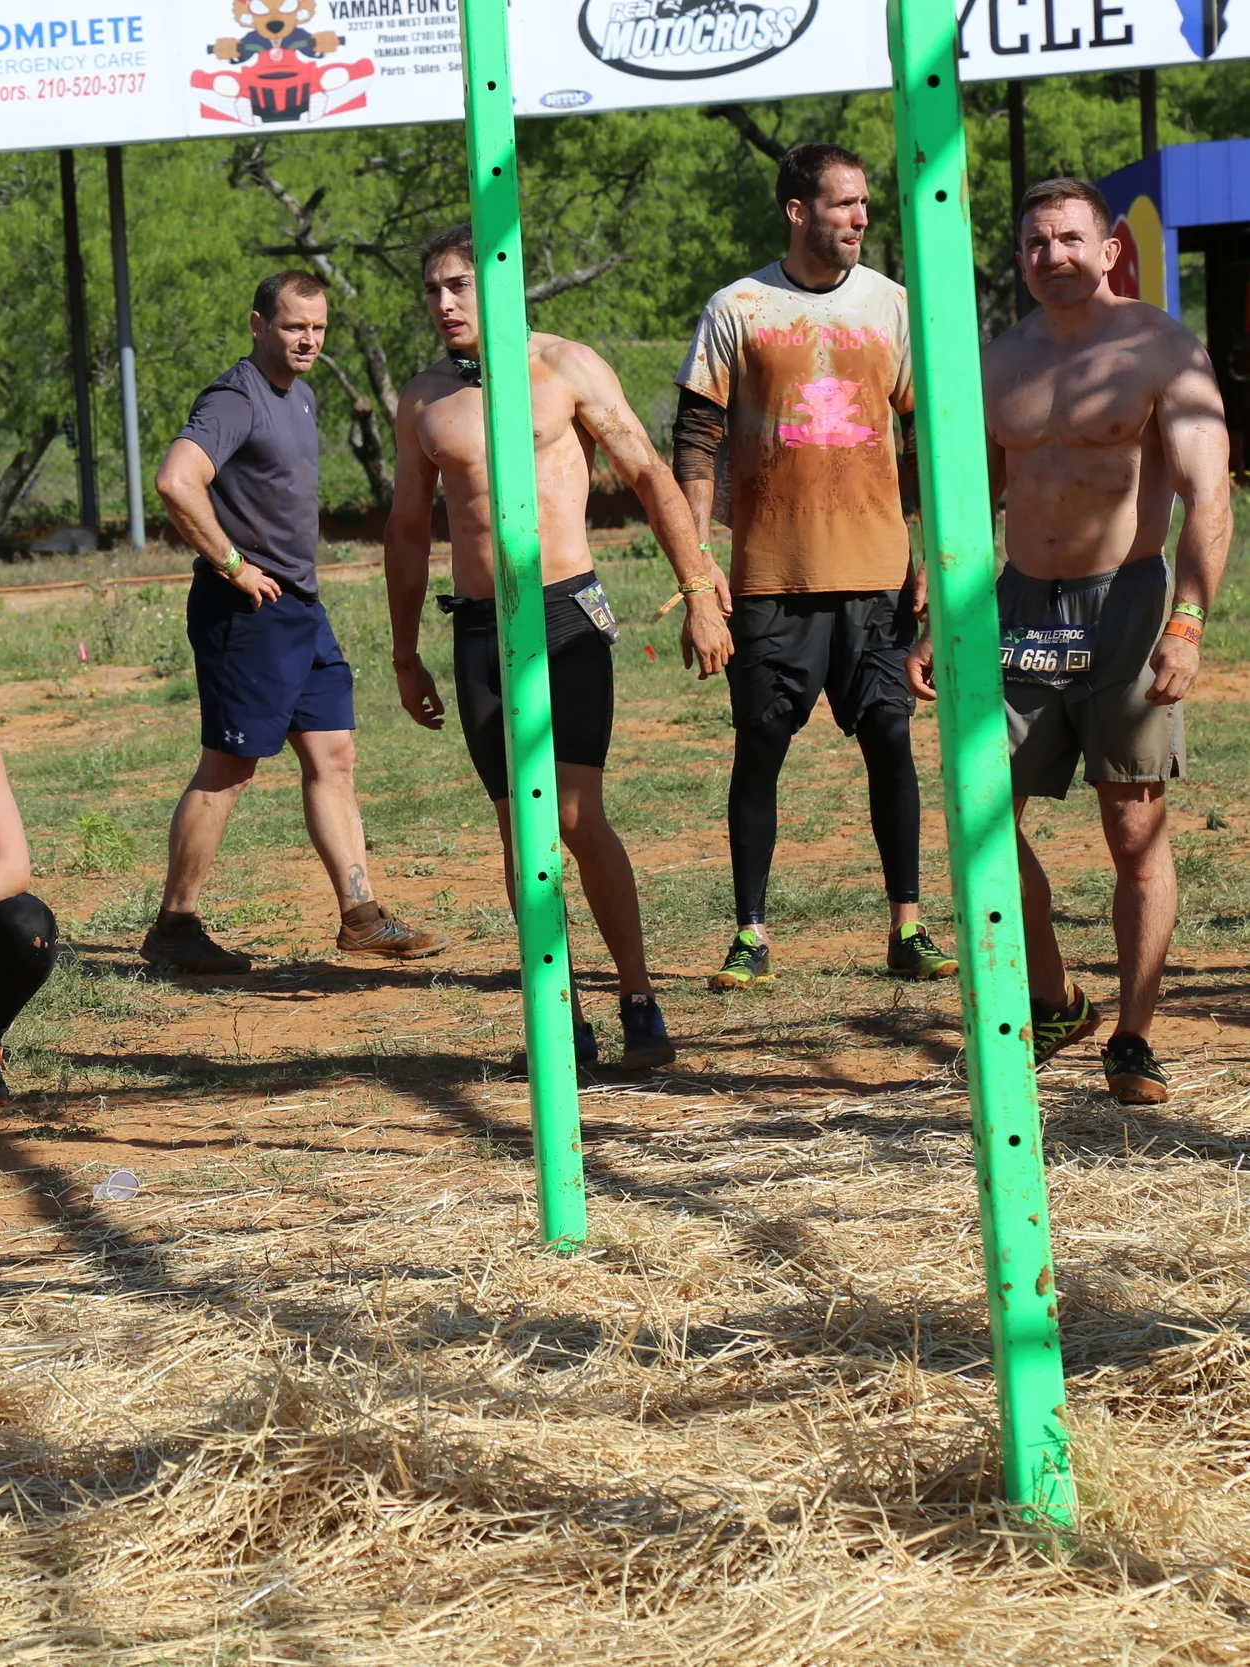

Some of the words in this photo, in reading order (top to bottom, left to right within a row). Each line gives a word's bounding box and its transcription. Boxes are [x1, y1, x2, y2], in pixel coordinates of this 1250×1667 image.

[329, 0, 402, 19] YAMAHA
[408, 0, 441, 14] FUN
[600, 6, 797, 61] MOTOCROSS
[93, 50, 147, 70] CARE
[380, 65, 406, 76] Parts
[414, 63, 440, 75] Sales
[37, 73, 147, 99] 210-520-3737
[756, 326, 806, 350] Mud
[1026, 629, 1084, 640] BATTLEFROG
[1019, 648, 1059, 672] 656
